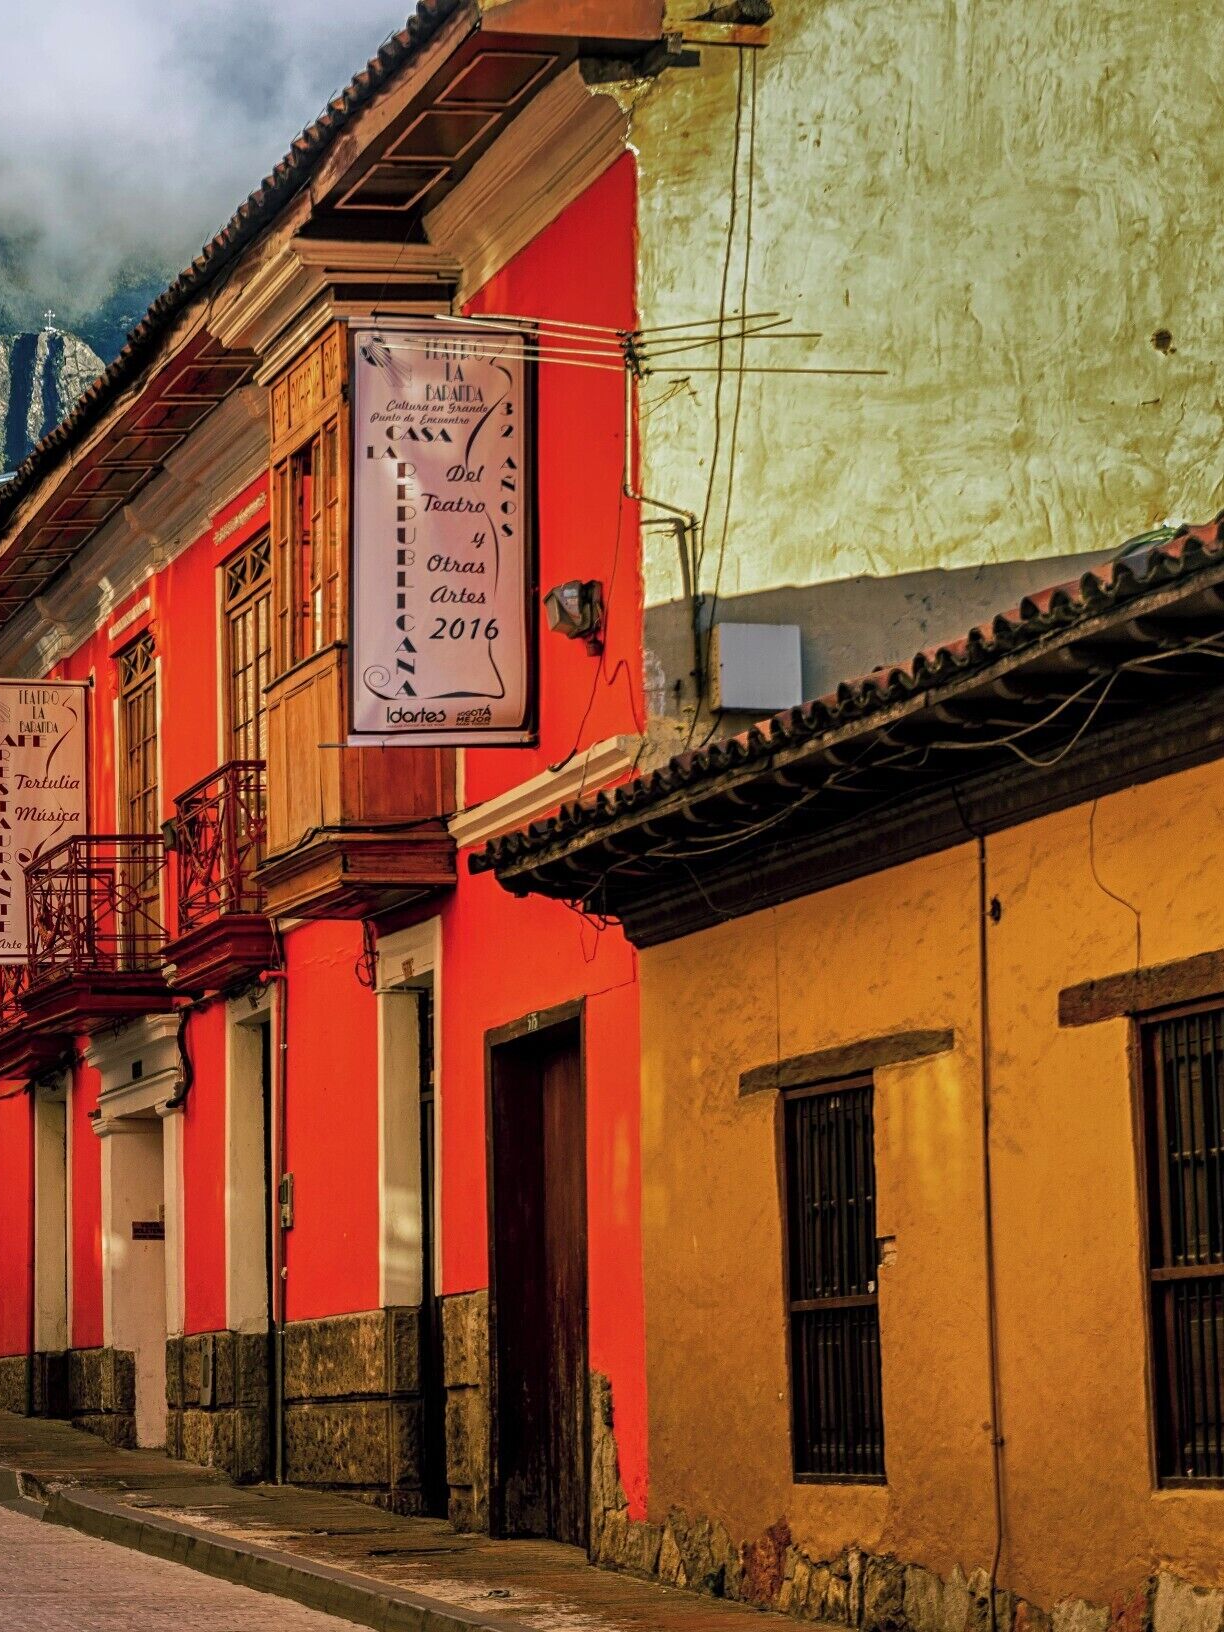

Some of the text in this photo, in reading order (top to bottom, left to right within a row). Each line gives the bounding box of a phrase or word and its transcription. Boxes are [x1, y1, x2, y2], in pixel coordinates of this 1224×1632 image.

[445, 362, 464, 382] LA
[386, 400, 429, 412] Cultura
[448, 402, 488, 414] Grande
[370, 412, 471, 425] Punto de Encuentro
[386, 425, 453, 443] CASA
[367, 445, 398, 461] LA
[446, 464, 485, 483] Del
[421, 493, 486, 514] Teatro
[500, 456, 517, 538] AÑOS
[471, 532, 485, 549] y
[426, 554, 486, 574] Otras
[395, 462, 418, 697] REPUBLICANA
[429, 585, 486, 604] Artes
[428, 617, 499, 640] 2016
[19, 690, 59, 705] TEATRO
[32, 706, 45, 720] LA
[14, 774, 80, 790] Tertulia
[15, 806, 80, 822] Música
